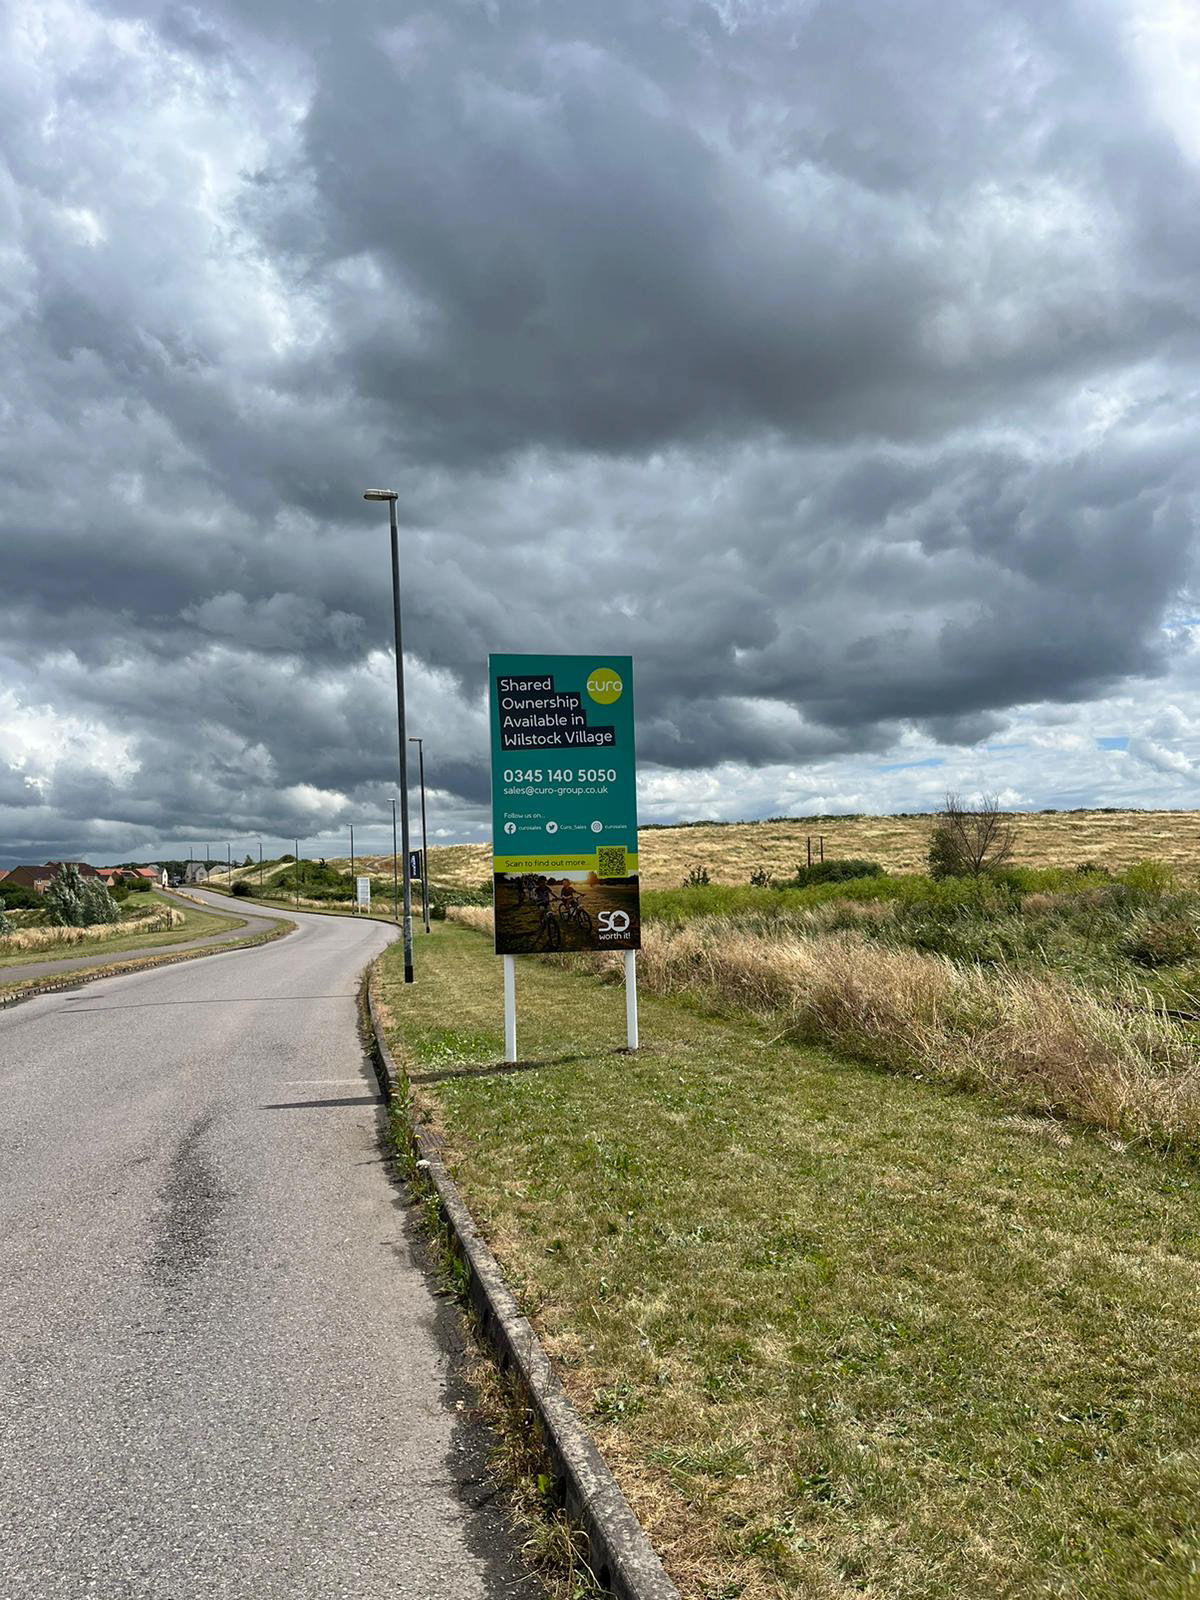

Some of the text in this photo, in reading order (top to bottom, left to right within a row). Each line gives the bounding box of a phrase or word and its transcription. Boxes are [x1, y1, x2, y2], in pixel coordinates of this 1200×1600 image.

[500, 677, 551, 692] Shared
[586, 679, 623, 692] curo
[501, 695, 579, 711] Ownership
[503, 713, 585, 728] Available in
[504, 731, 613, 746] Wilstock Village
[503, 769, 617, 783] 0345 140 5050
[503, 785, 609, 797] sales@curo-group.co.uk
[535, 859, 549, 867] find
[597, 910, 630, 932] SO
[598, 931, 631, 941] worth it!
